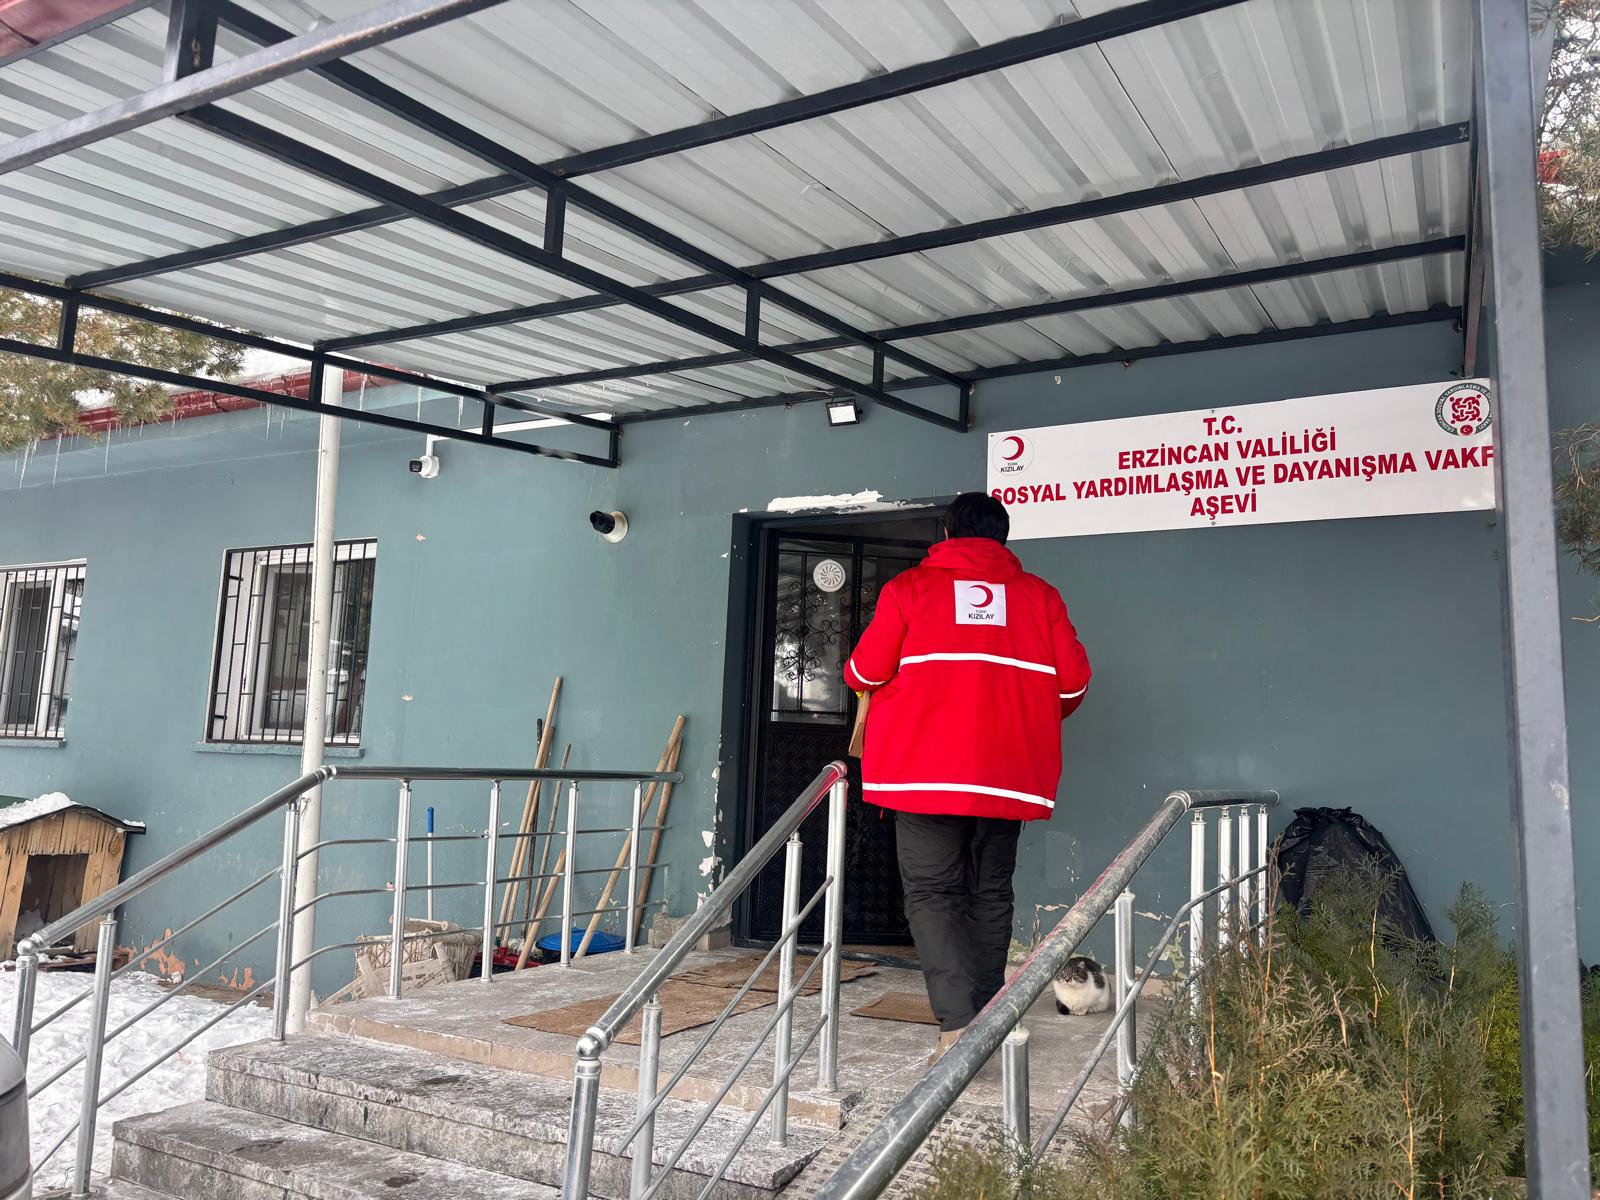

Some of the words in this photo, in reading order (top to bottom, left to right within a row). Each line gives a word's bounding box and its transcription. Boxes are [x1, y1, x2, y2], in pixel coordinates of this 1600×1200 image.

[1203, 415, 1243, 437] T.C.
[1118, 441, 1229, 470] ERZİNCAN
[1237, 427, 1336, 460] VALİLİĞİ
[991, 483, 1066, 506] SOSYAL
[1073, 467, 1229, 500] YARDIMLAŞMA
[1236, 465, 1265, 487] VE
[1274, 452, 1417, 484] DAYANIŞMA
[1425, 445, 1494, 471] VAKF
[1000, 464, 1025, 473] KIZILAY
[1190, 488, 1257, 521] AŞEVİ
